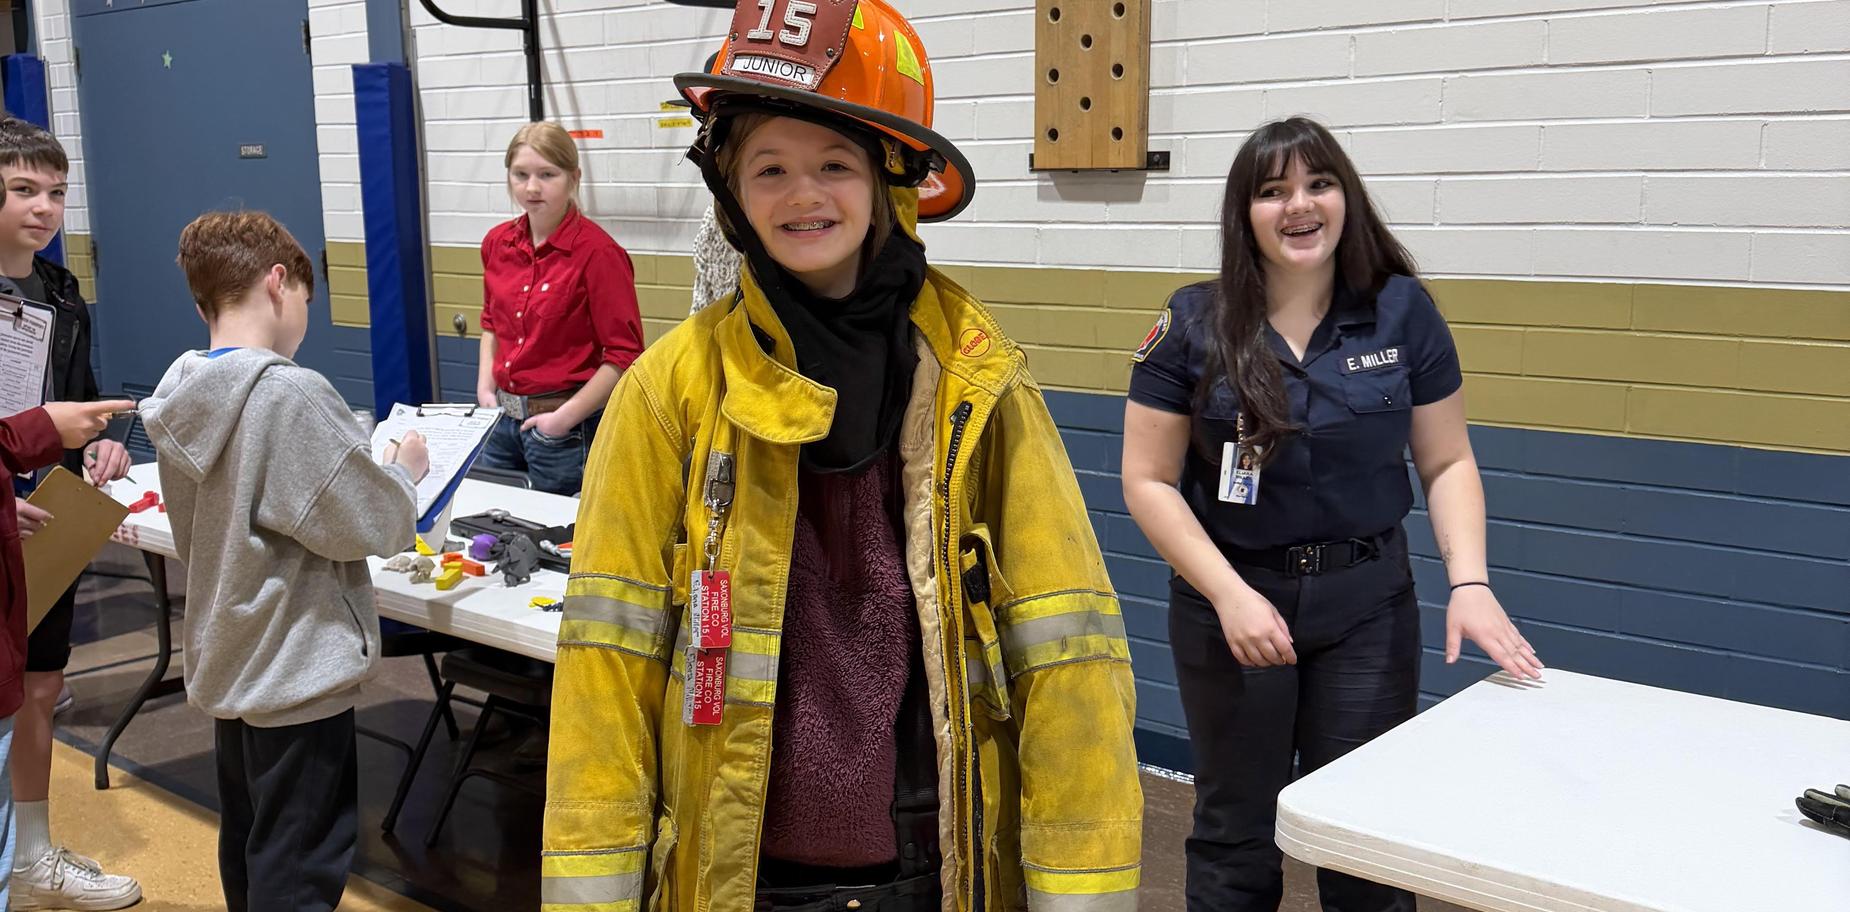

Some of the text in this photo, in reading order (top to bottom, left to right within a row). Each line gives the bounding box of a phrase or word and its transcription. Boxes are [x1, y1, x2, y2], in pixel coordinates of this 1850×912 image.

[747, 0, 817, 46] 15
[743, 56, 807, 81] JUNIOR
[963, 332, 987, 354] GLOBE
[1346, 348, 1399, 371] E. MILLER
[701, 585, 710, 634] STATION 15
[711, 591, 719, 627] FIRE CO
[720, 579, 729, 639] SAXONBURG VOL
[694, 661, 705, 710] STATION 15
[704, 668, 714, 704] FIRE CO
[712, 656, 723, 716] SAXONBURG VOL
